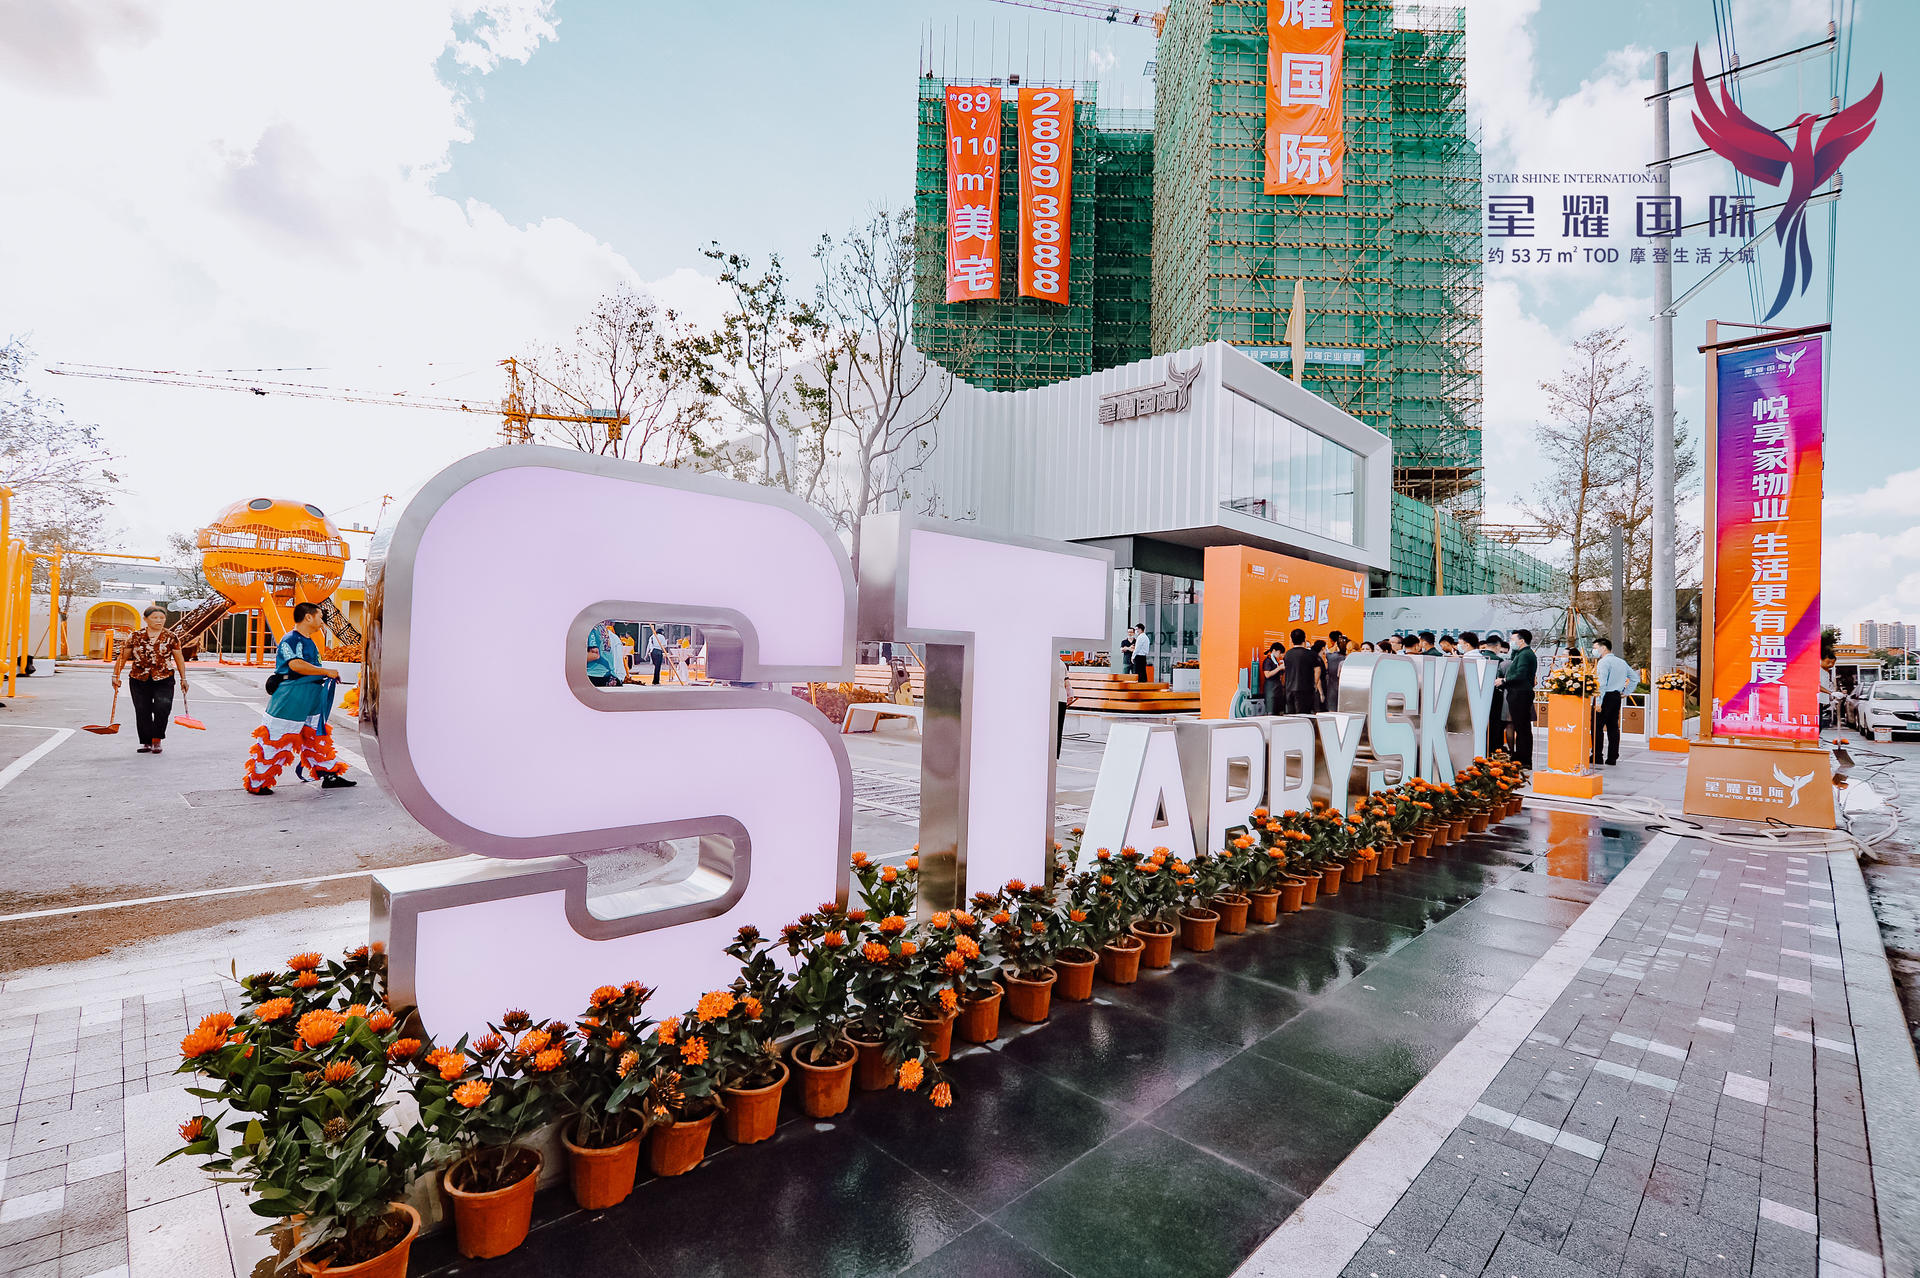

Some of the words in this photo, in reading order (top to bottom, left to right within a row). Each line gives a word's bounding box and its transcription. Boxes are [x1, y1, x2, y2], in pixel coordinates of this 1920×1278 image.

[1751, 394, 1790, 523] 悦享家物业
[1749, 532, 1790, 685] 生活更有温度
[1338, 652, 1498, 790] SKY
